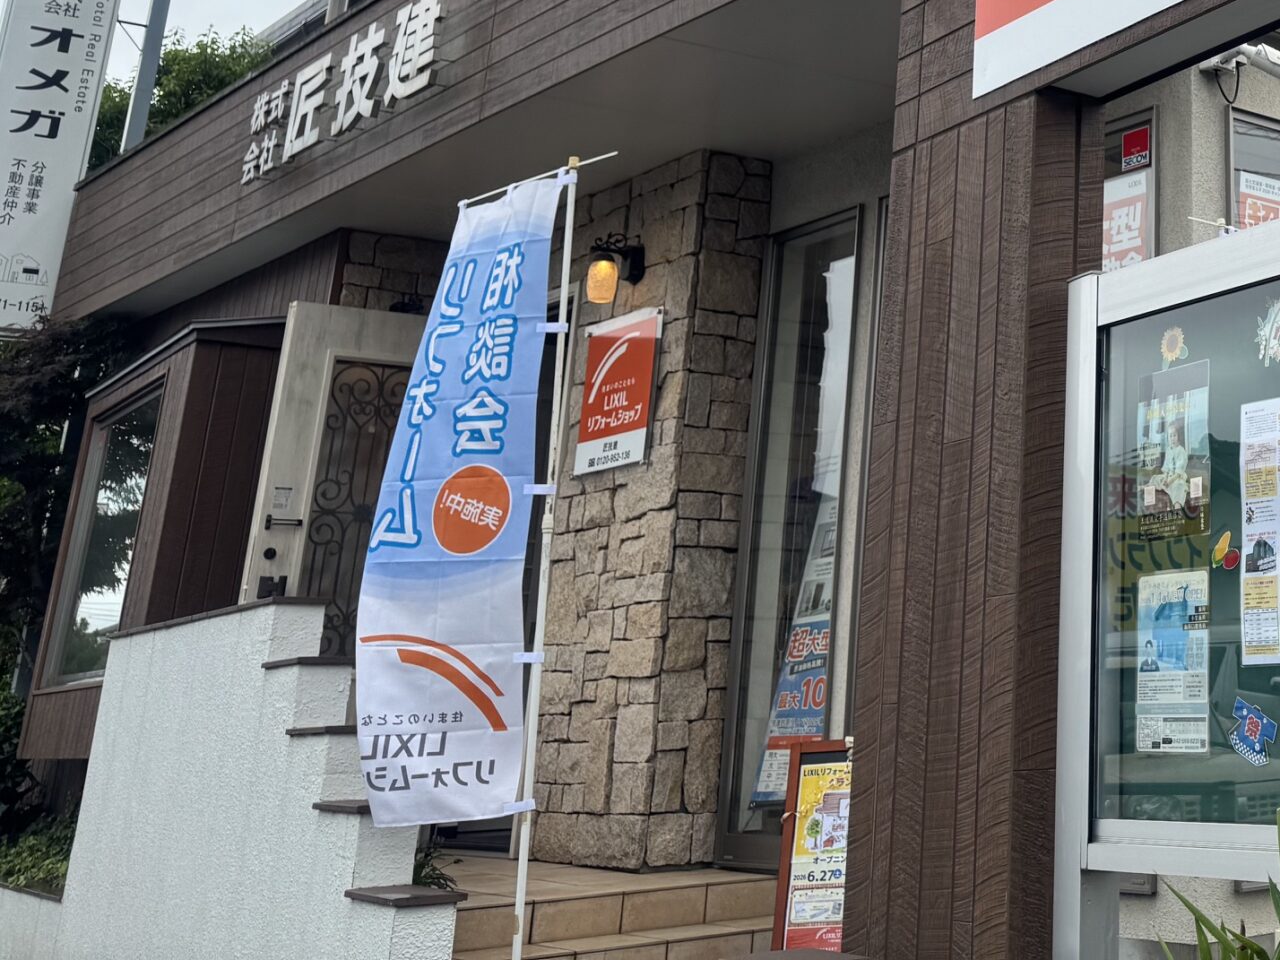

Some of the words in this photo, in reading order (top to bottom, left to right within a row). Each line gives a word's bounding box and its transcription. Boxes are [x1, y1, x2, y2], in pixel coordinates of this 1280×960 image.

[84, 32, 103, 64] Real
[9, 24, 85, 140] オメガ
[73, 68, 96, 114] Estate
[1123, 154, 1148, 169] SECOM
[0, 157, 28, 227] 不動産仲介
[22, 160, 47, 215] 分譲事業
[587, 402, 643, 433] リフォームショップ
[604, 391, 628, 411] LIXIL
